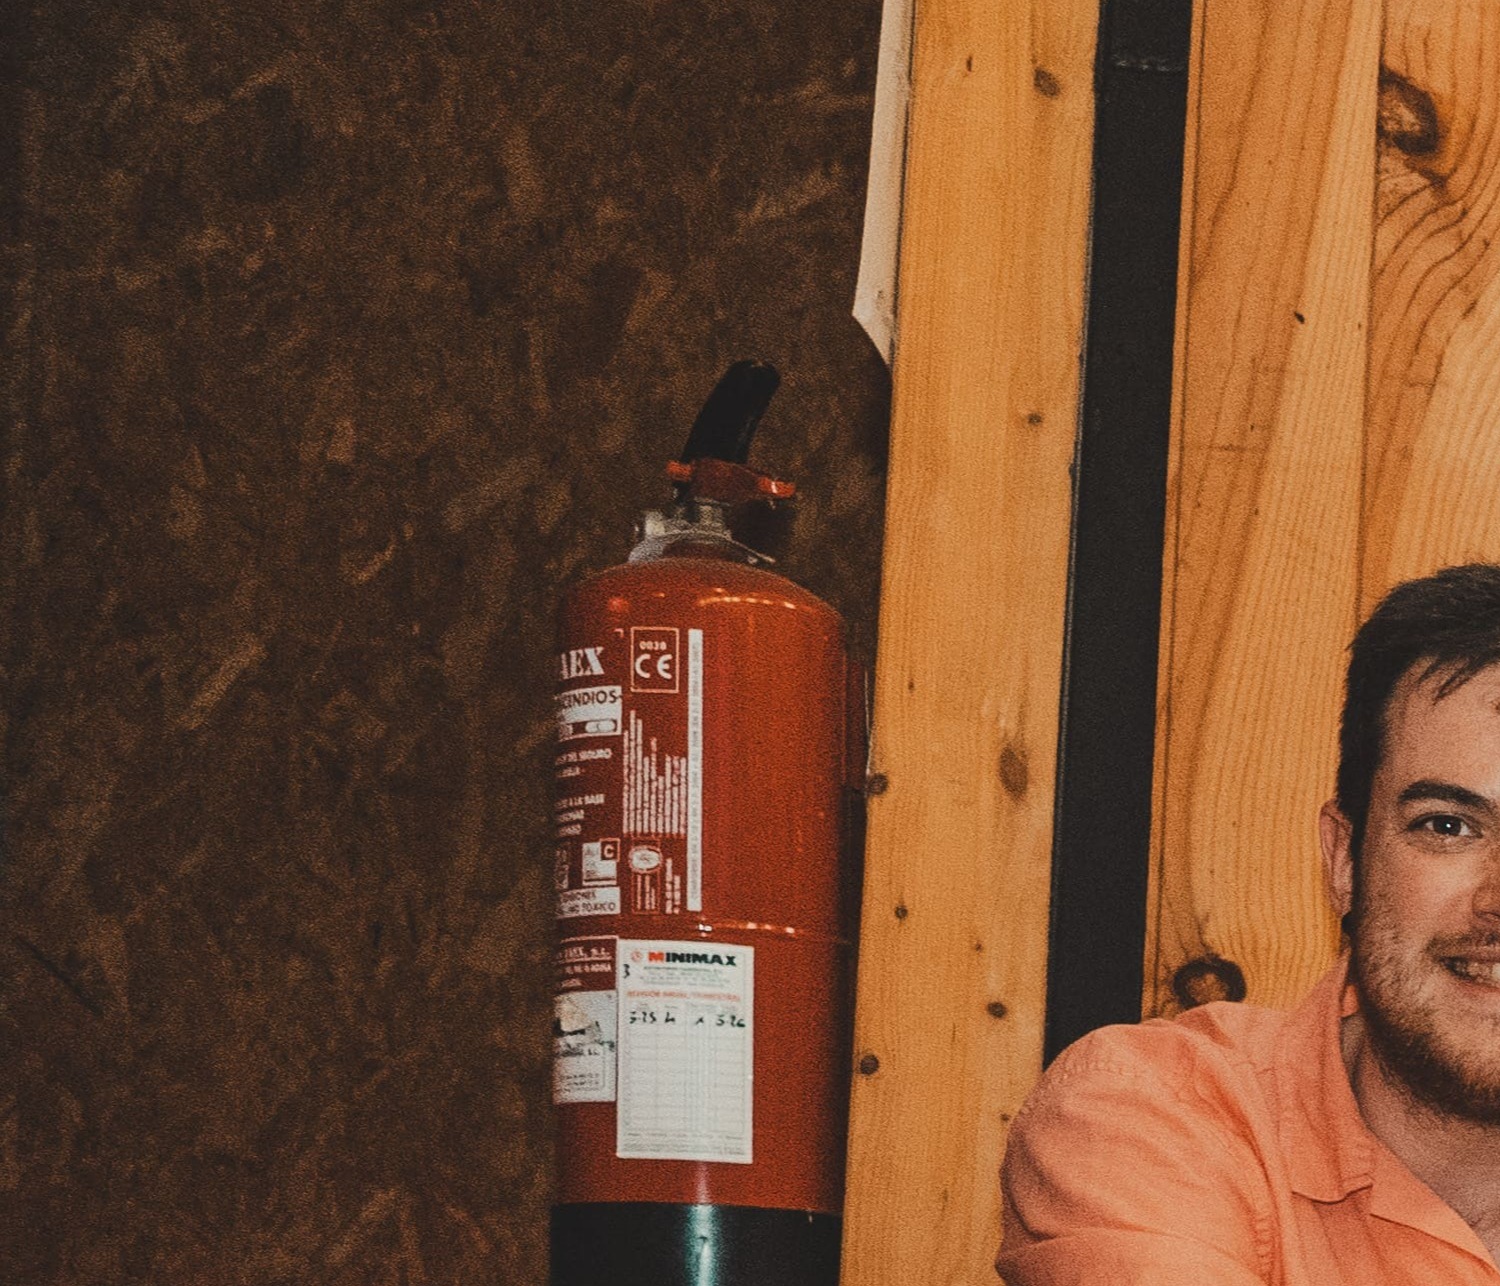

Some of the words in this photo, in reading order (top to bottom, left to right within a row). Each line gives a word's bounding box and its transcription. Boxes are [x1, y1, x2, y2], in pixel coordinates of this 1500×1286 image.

[634, 653, 674, 680] CE
[603, 845, 614, 858] C
[648, 950, 737, 967] MINIMAX
